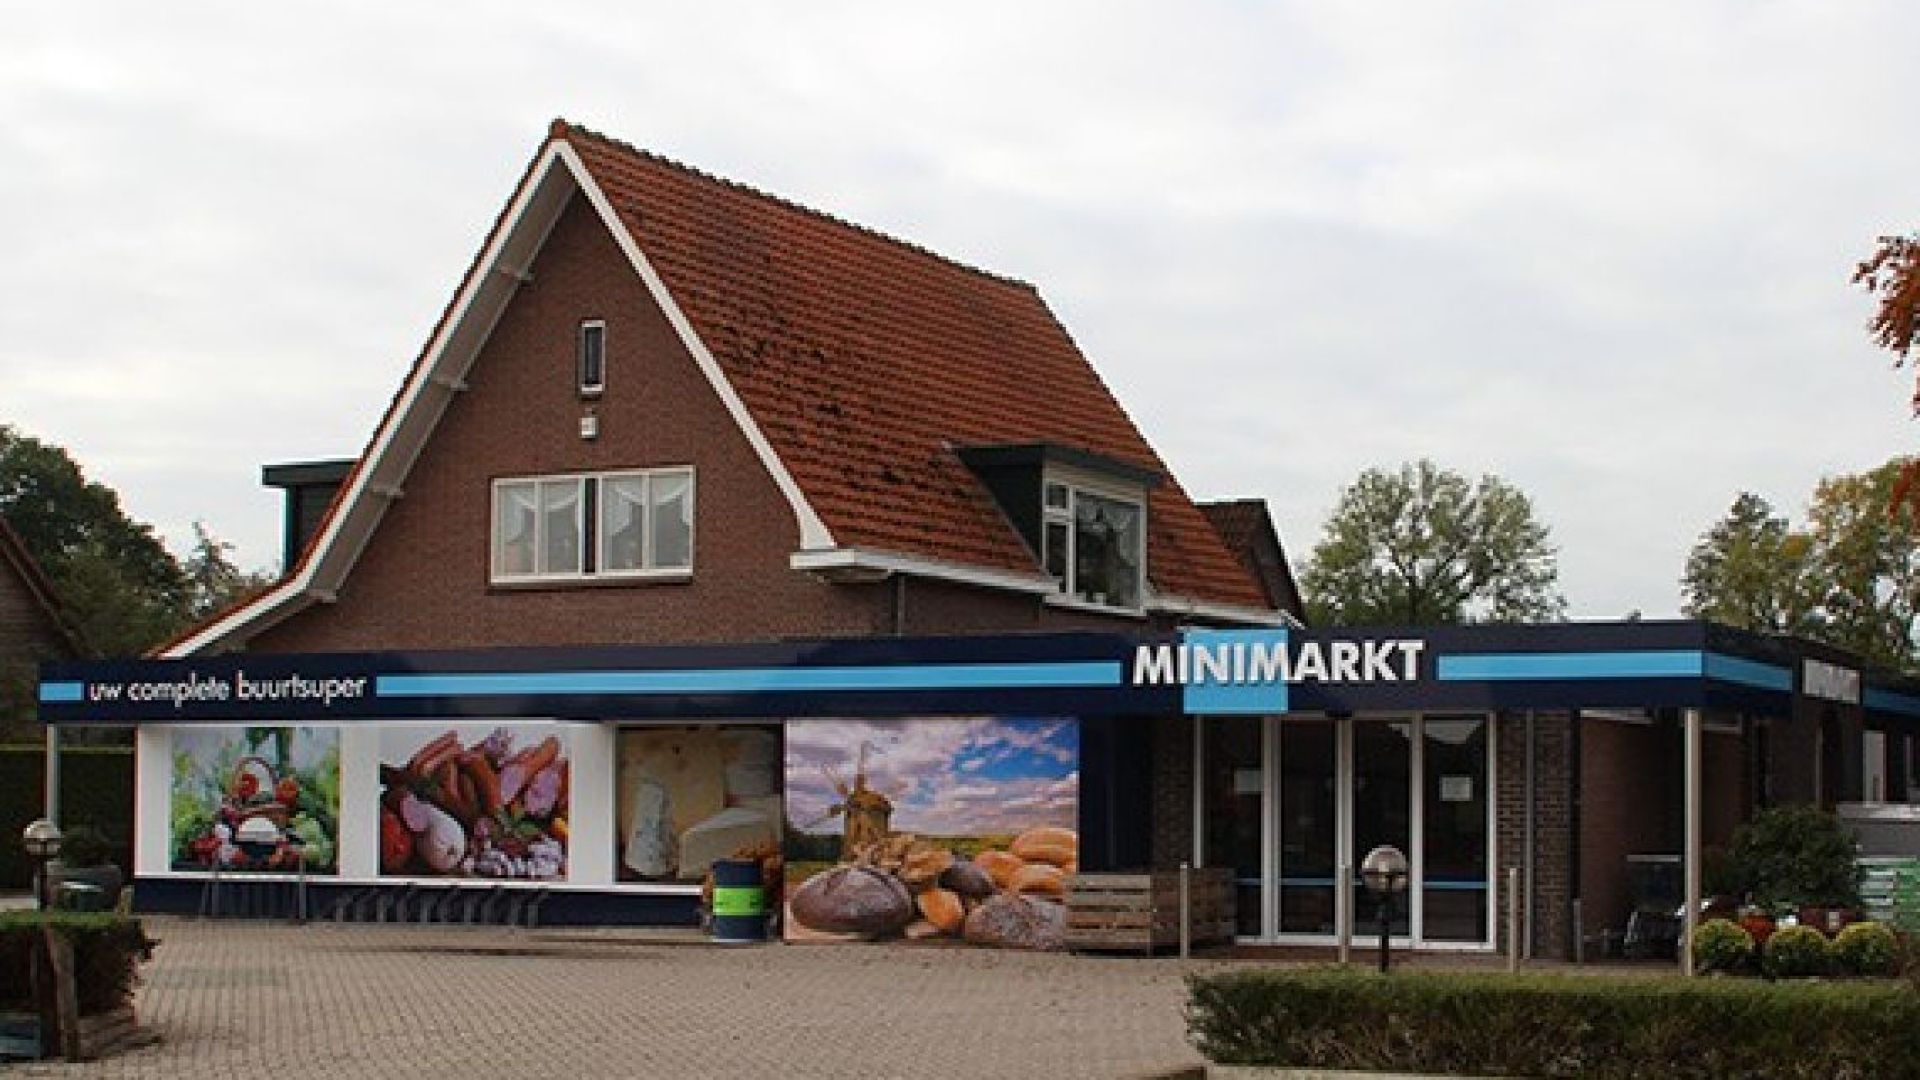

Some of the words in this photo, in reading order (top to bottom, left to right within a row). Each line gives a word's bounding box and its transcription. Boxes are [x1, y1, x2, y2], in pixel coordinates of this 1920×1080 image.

[1132, 640, 1424, 685] MINIMARKT
[89, 683, 122, 701] uw
[127, 670, 230, 708] complete
[235, 669, 367, 707] buurtsuper
